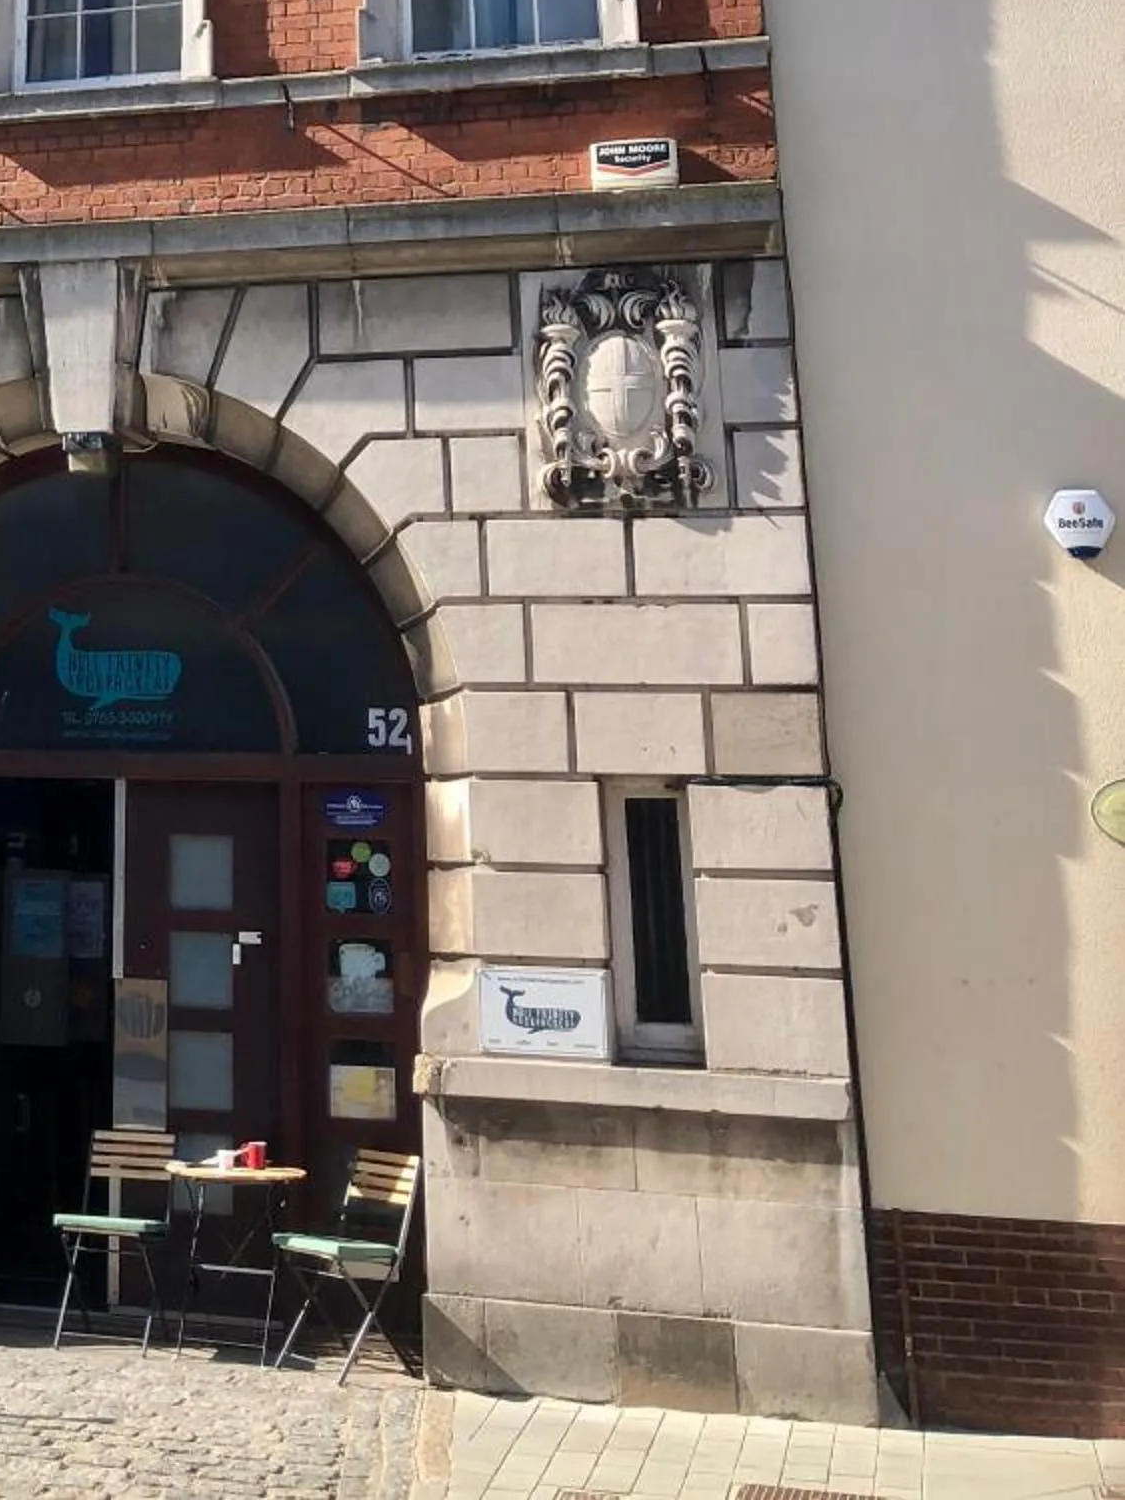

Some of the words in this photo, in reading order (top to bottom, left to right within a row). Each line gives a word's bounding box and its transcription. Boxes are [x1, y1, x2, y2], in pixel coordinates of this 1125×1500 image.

[599, 145, 625, 156] JOHN
[629, 143, 666, 153] MOORE
[614, 154, 652, 163] Security
[1058, 517, 1104, 529] BeeSafe
[368, 707, 408, 747] 52
